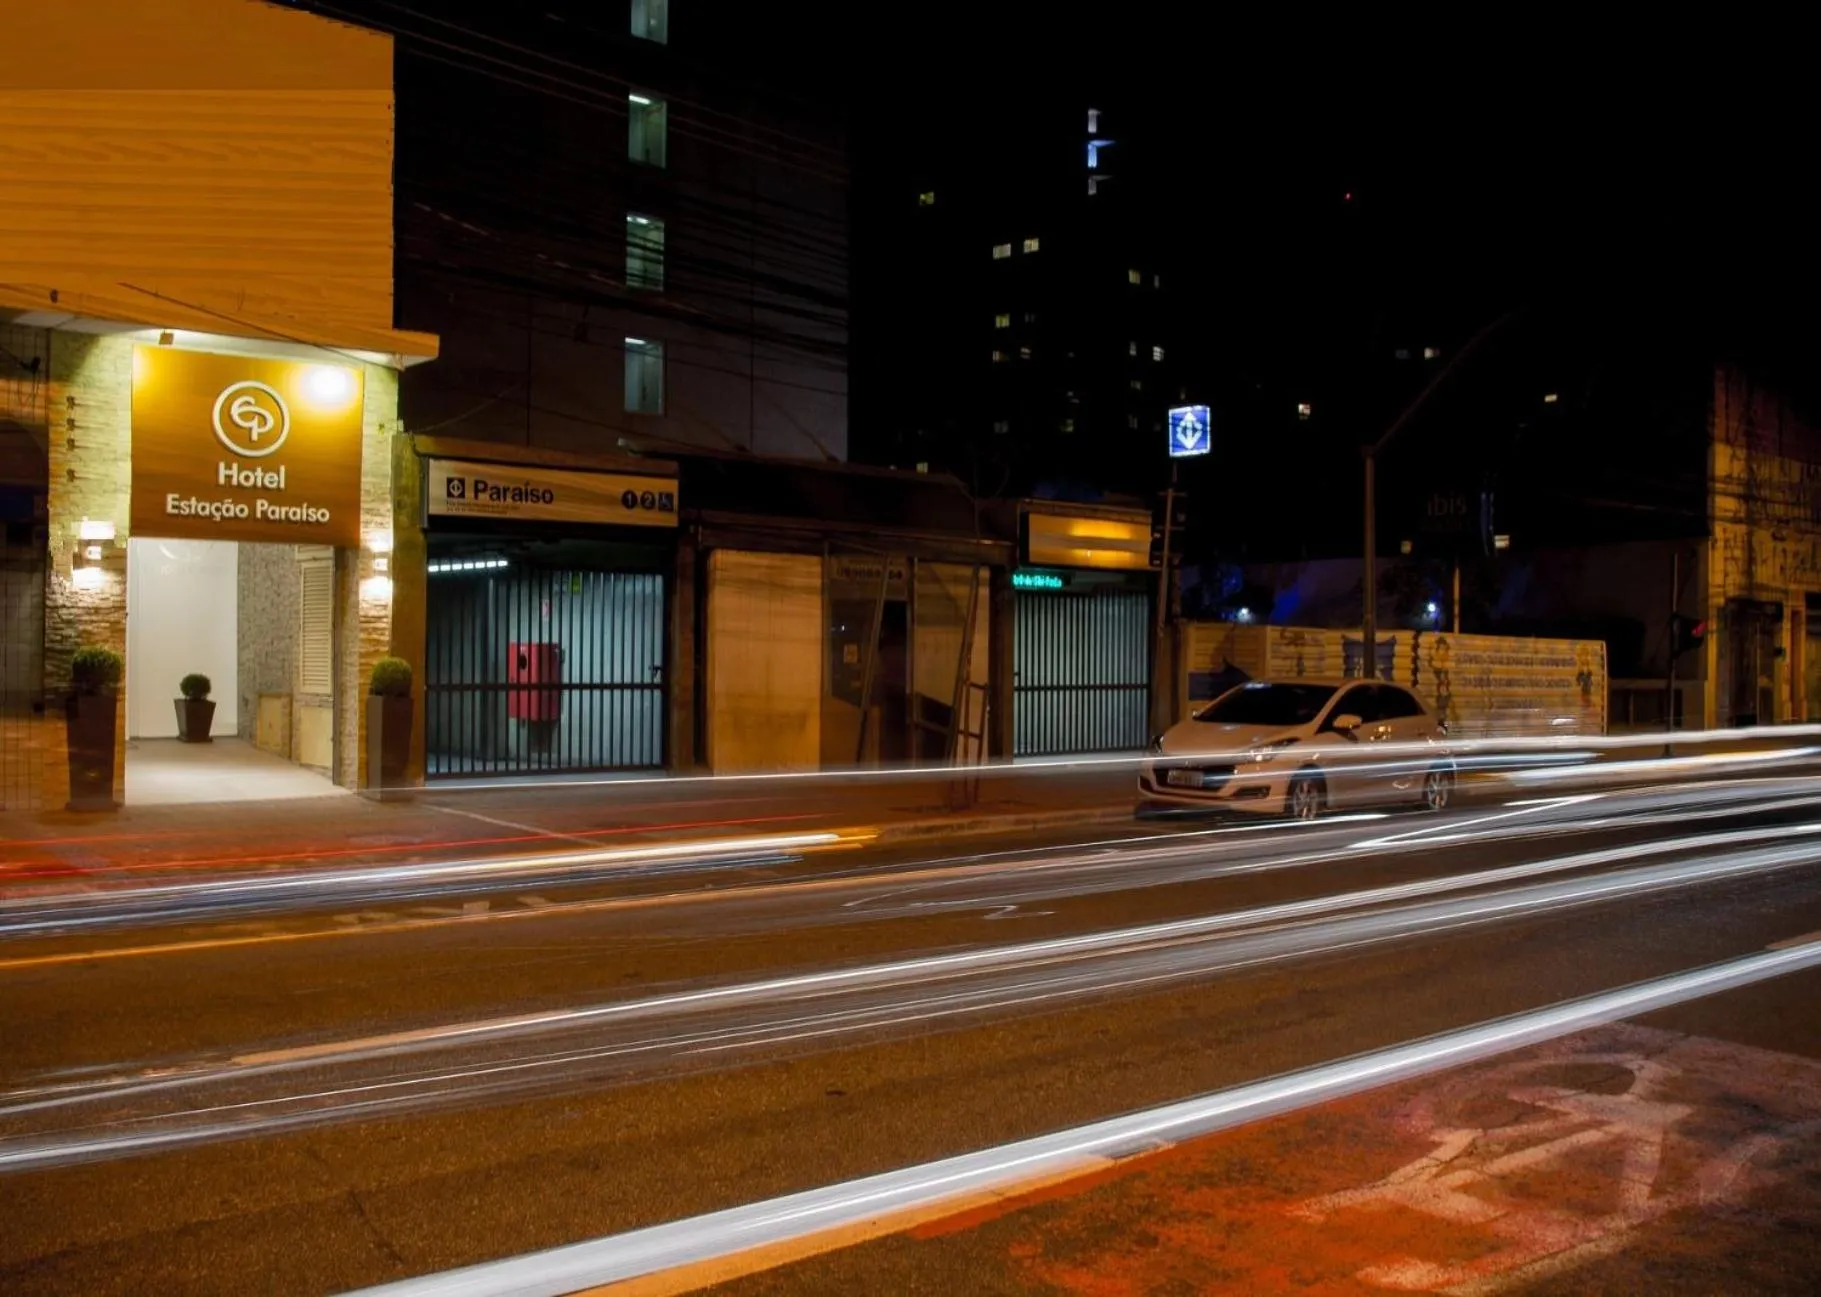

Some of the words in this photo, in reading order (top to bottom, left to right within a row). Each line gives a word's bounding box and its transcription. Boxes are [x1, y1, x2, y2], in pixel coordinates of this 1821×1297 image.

[217, 461, 286, 489] Hotel
[473, 479, 555, 505] Paraíso
[1427, 490, 1468, 517] ibis
[165, 493, 249, 521] Estação
[255, 499, 330, 523] Paraíso
